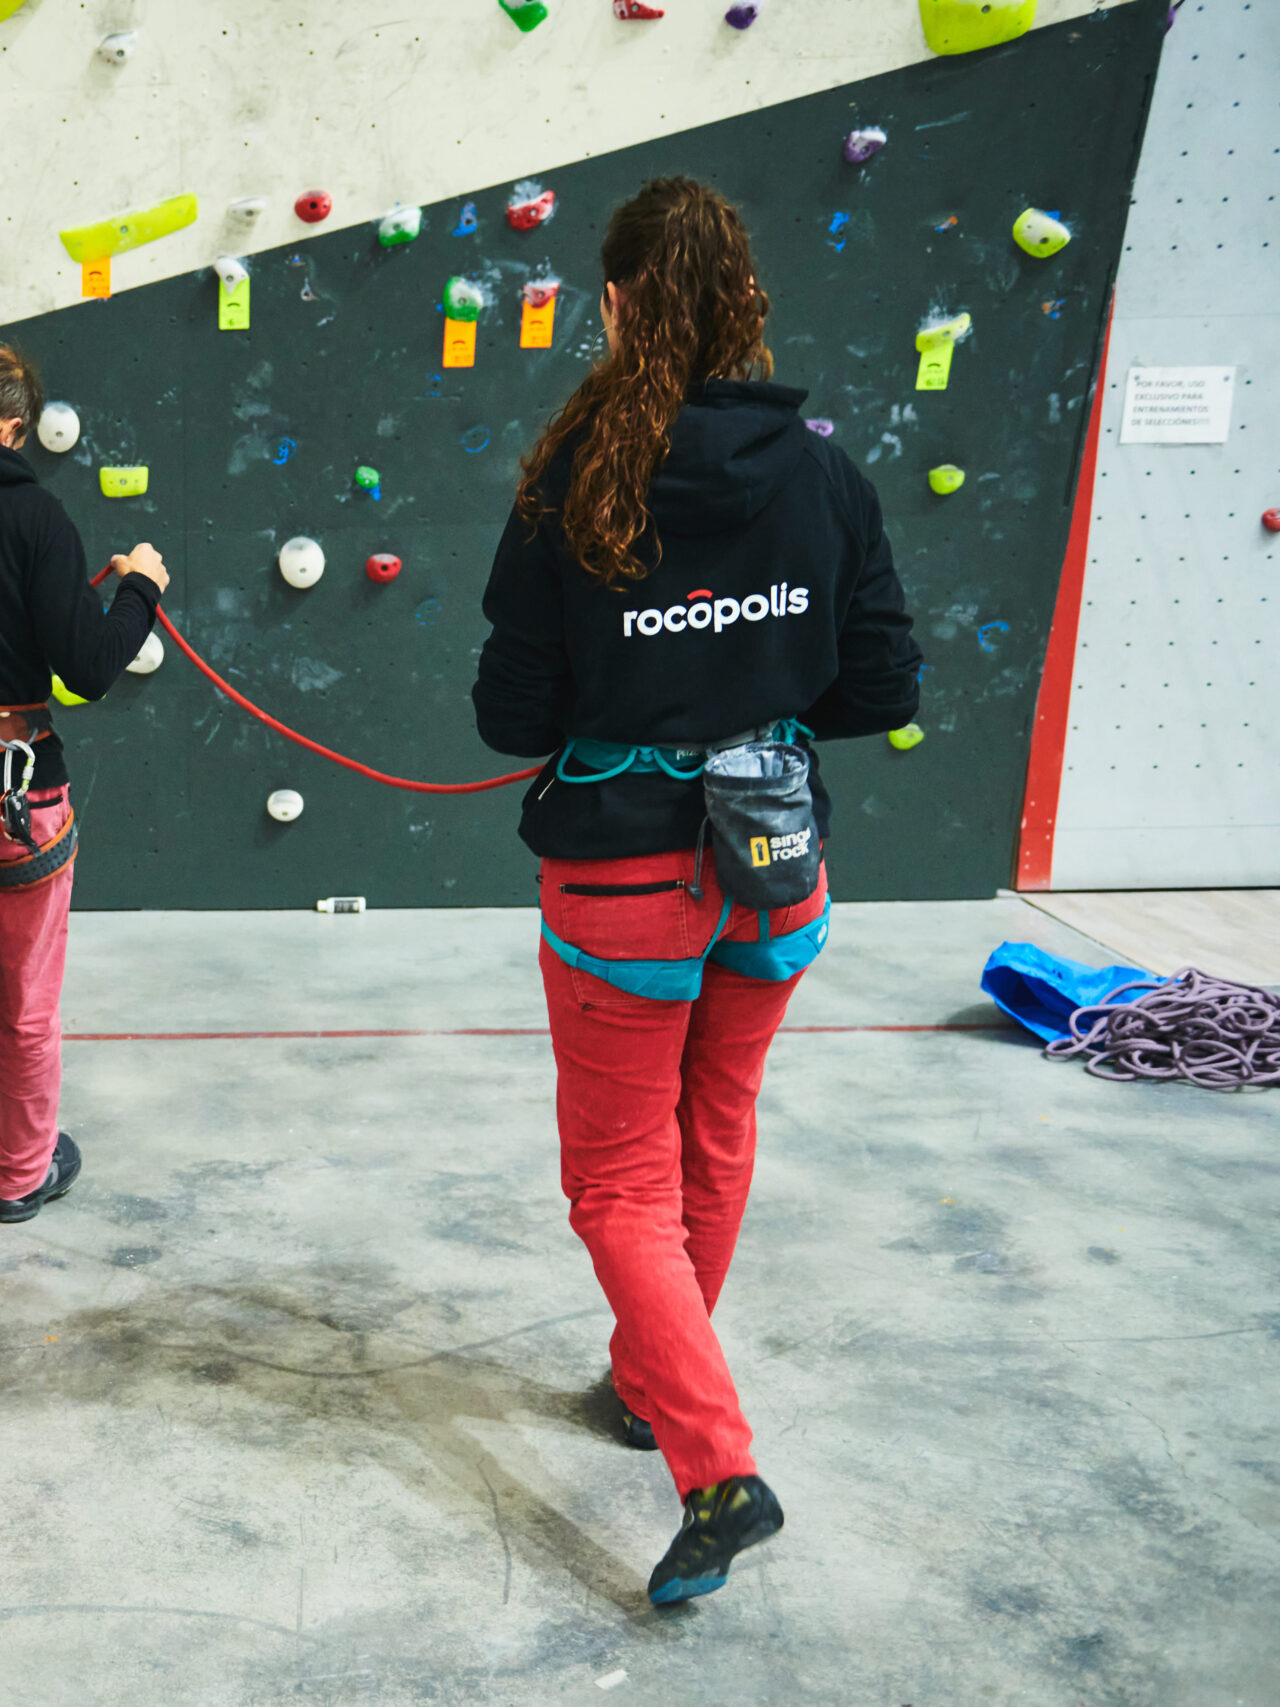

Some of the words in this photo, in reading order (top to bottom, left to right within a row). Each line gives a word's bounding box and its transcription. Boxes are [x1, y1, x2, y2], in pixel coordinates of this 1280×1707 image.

[1136, 380, 1152, 388] POR
[1134, 393, 1180, 401] EXCLUSIVO
[1181, 393, 1203, 401] PARA
[1133, 405, 1209, 413] ENTRENAMIENTOS
